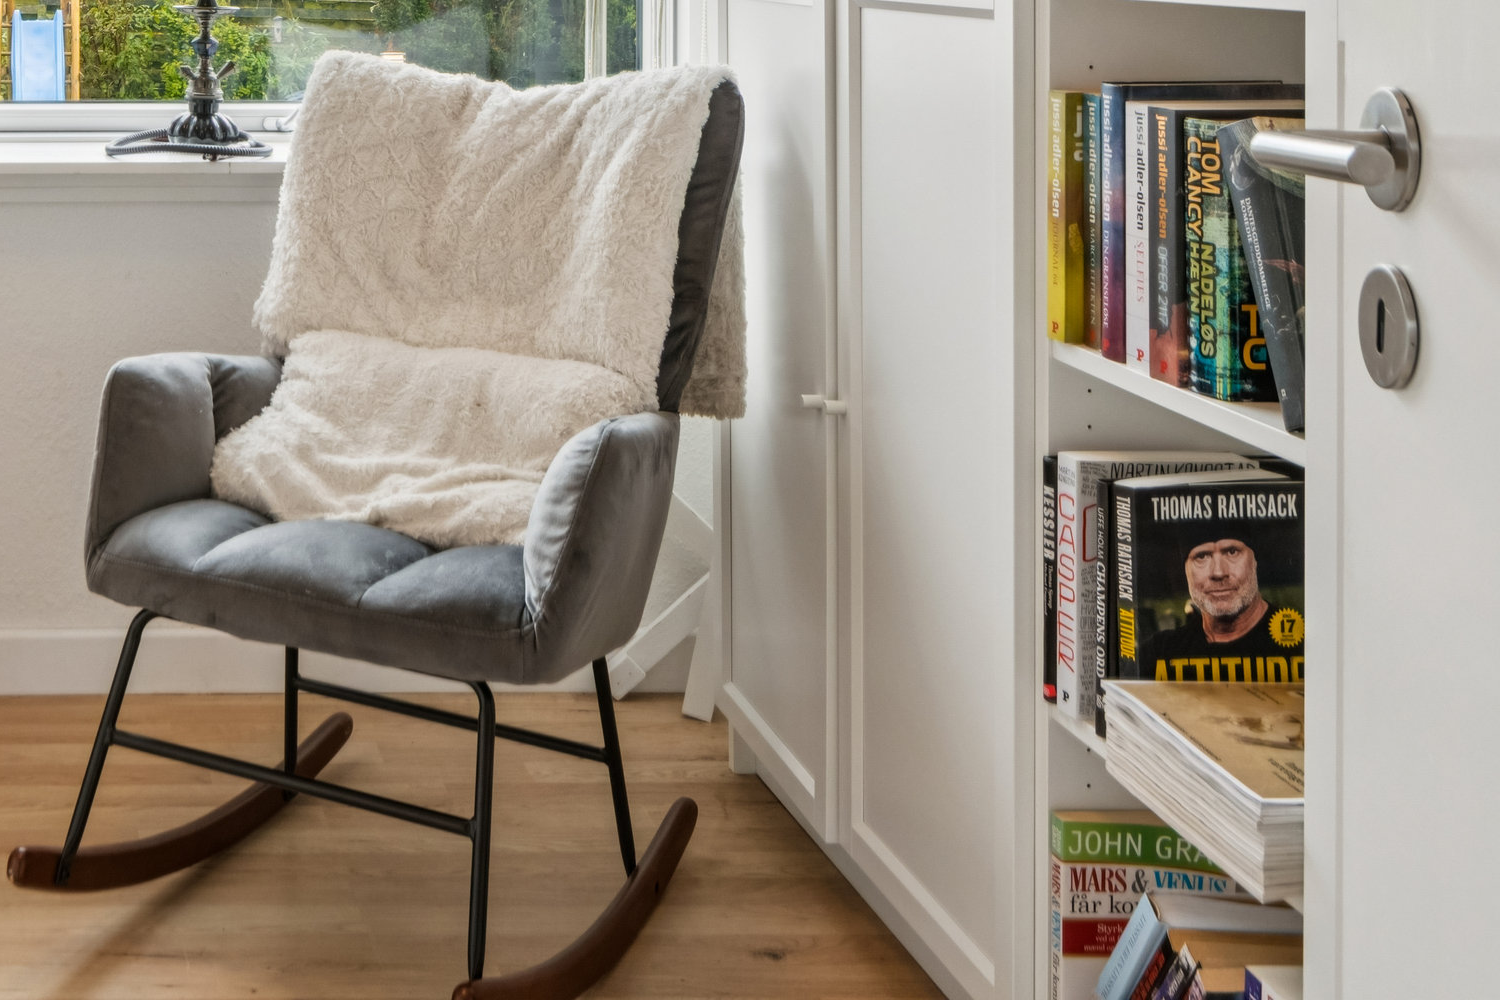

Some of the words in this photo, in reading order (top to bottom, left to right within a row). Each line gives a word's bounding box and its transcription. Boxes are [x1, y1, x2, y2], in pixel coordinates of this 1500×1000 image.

[1051, 98, 1062, 132] jussi
[1087, 101, 1097, 136] jussi
[1102, 94, 1113, 131] jussi
[1135, 111, 1145, 145] jussi
[1156, 114, 1168, 150] jussi
[1051, 133, 1062, 218] adler-olsen
[1088, 137, 1097, 224] adler-olsen
[1102, 132, 1113, 222] adler-olsen
[1135, 148, 1146, 231] adler-olsen
[1186, 136, 1203, 238] CLANCY
[1201, 138, 1220, 195] TOM
[1158, 153, 1168, 239] adler-olsen
[1239, 199, 1253, 243] KOMEDIE
[1052, 221, 1060, 272] JOURNAL
[1088, 226, 1096, 267] MARCO
[1136, 241, 1145, 303] SELFIES
[1157, 245, 1168, 291] OFFER
[1088, 269, 1096, 325] EFFEKTEN
[1102, 255, 1110, 329] GRÆNSELØSE
[1188, 241, 1200, 315] HÆVN
[1200, 242, 1217, 357] NÅDELØS
[1043, 484, 1056, 562] KESSLER
[1097, 507, 1105, 530] UFFE
[1116, 495, 1133, 541] THOMAS
[1151, 495, 1213, 521] THOMAS
[1218, 493, 1298, 519] RATHSACK
[1097, 531, 1105, 559] HOLM
[1057, 492, 1077, 673] CASPER
[1117, 543, 1134, 602] RATHSACK
[1095, 561, 1107, 643] CHAMPENS
[1280, 618, 1297, 634] 17
[1119, 607, 1136, 662] ATTITUDE
[1095, 645, 1107, 679] ORD
[1068, 830, 1143, 857] JOHN
[1069, 866, 1127, 893] MARS
[1131, 869, 1149, 893] &
[1153, 870, 1227, 893] VENUS
[1070, 894, 1102, 914] får
